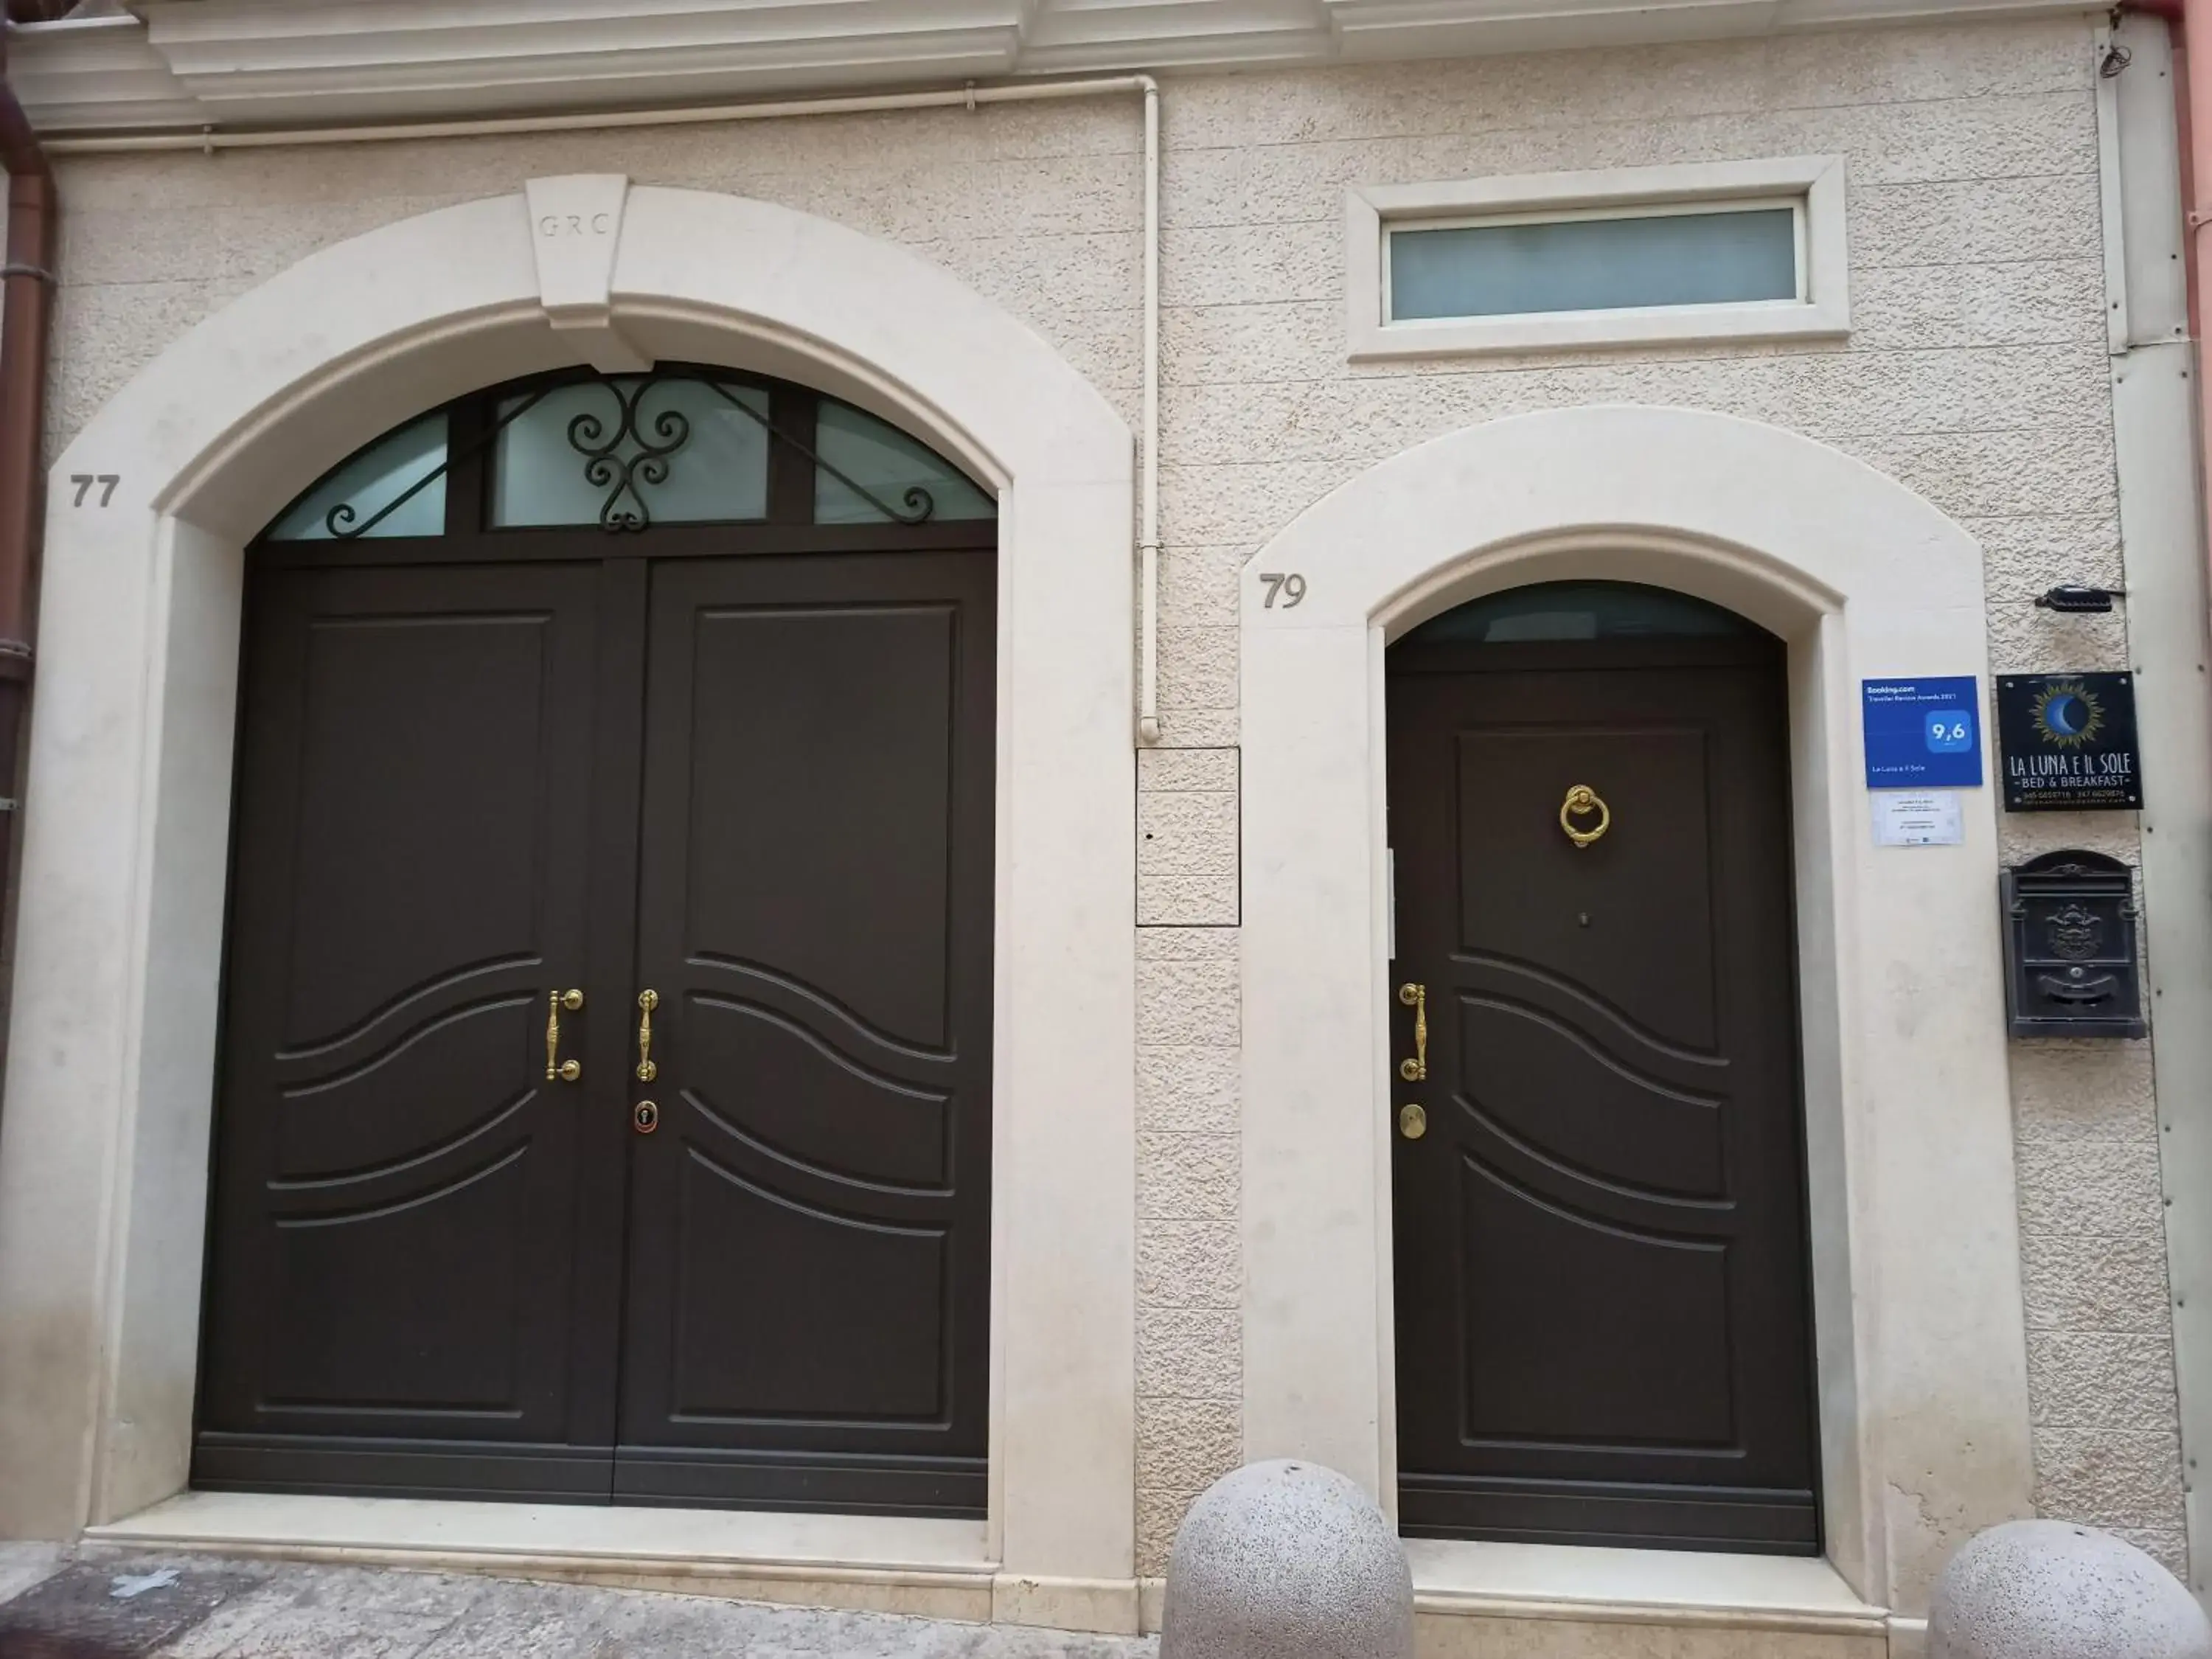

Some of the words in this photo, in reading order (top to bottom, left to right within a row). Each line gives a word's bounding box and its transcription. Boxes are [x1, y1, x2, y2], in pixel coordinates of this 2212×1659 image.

[539, 212, 609, 237] GRC
[70, 474, 120, 508] 77
[1259, 573, 1307, 608] 79
[1867, 686, 1916, 695] Booking.com
[1932, 723, 1966, 742] 9,6
[2010, 754, 2026, 776] LA
[2029, 754, 2068, 775] LUNA
[2072, 756, 2080, 775] E
[2099, 752, 2132, 773] SOLE
[2049, 776, 2056, 787] &
